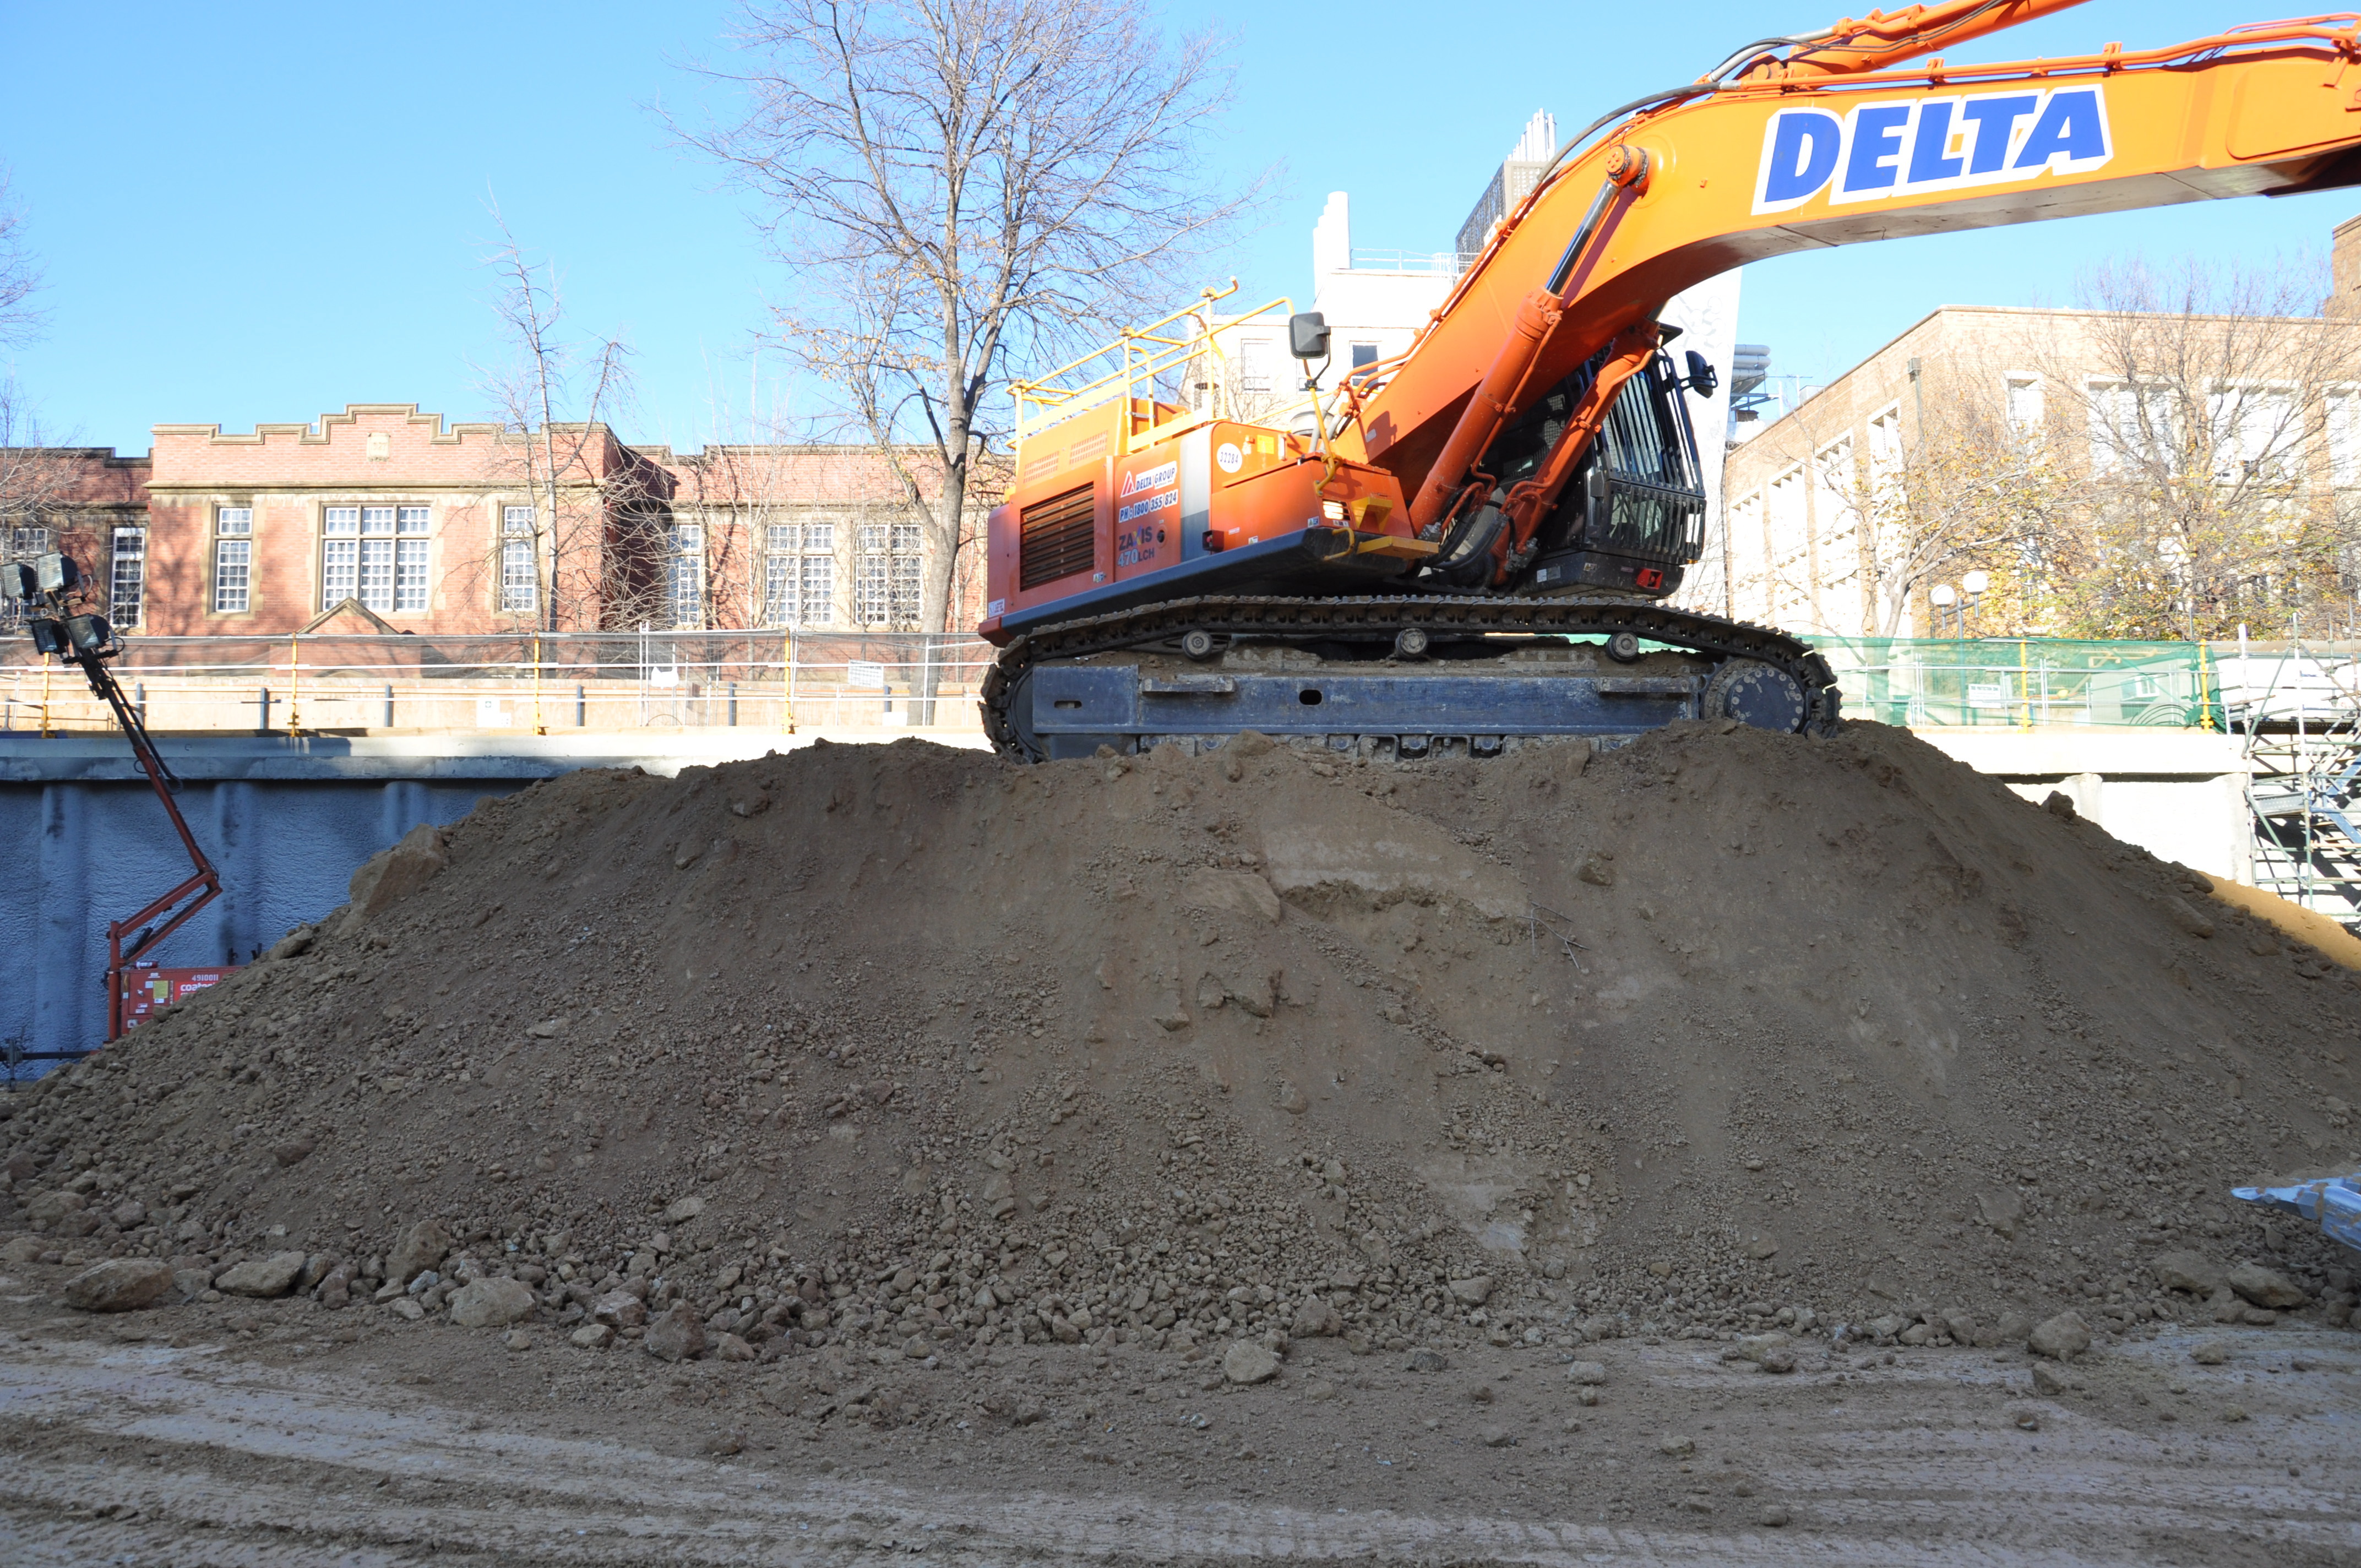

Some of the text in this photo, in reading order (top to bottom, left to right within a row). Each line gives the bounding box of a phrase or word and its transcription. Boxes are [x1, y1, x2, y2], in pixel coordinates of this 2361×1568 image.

[1760, 87, 2108, 206] DELTA
[1136, 476, 1152, 491] DELTA
[1155, 467, 1175, 484] GROUP
[1134, 501, 1149, 516] 1800
[1150, 496, 1163, 511] 355
[1165, 491, 1177, 505] 824
[1119, 525, 1153, 551] ZAXIS
